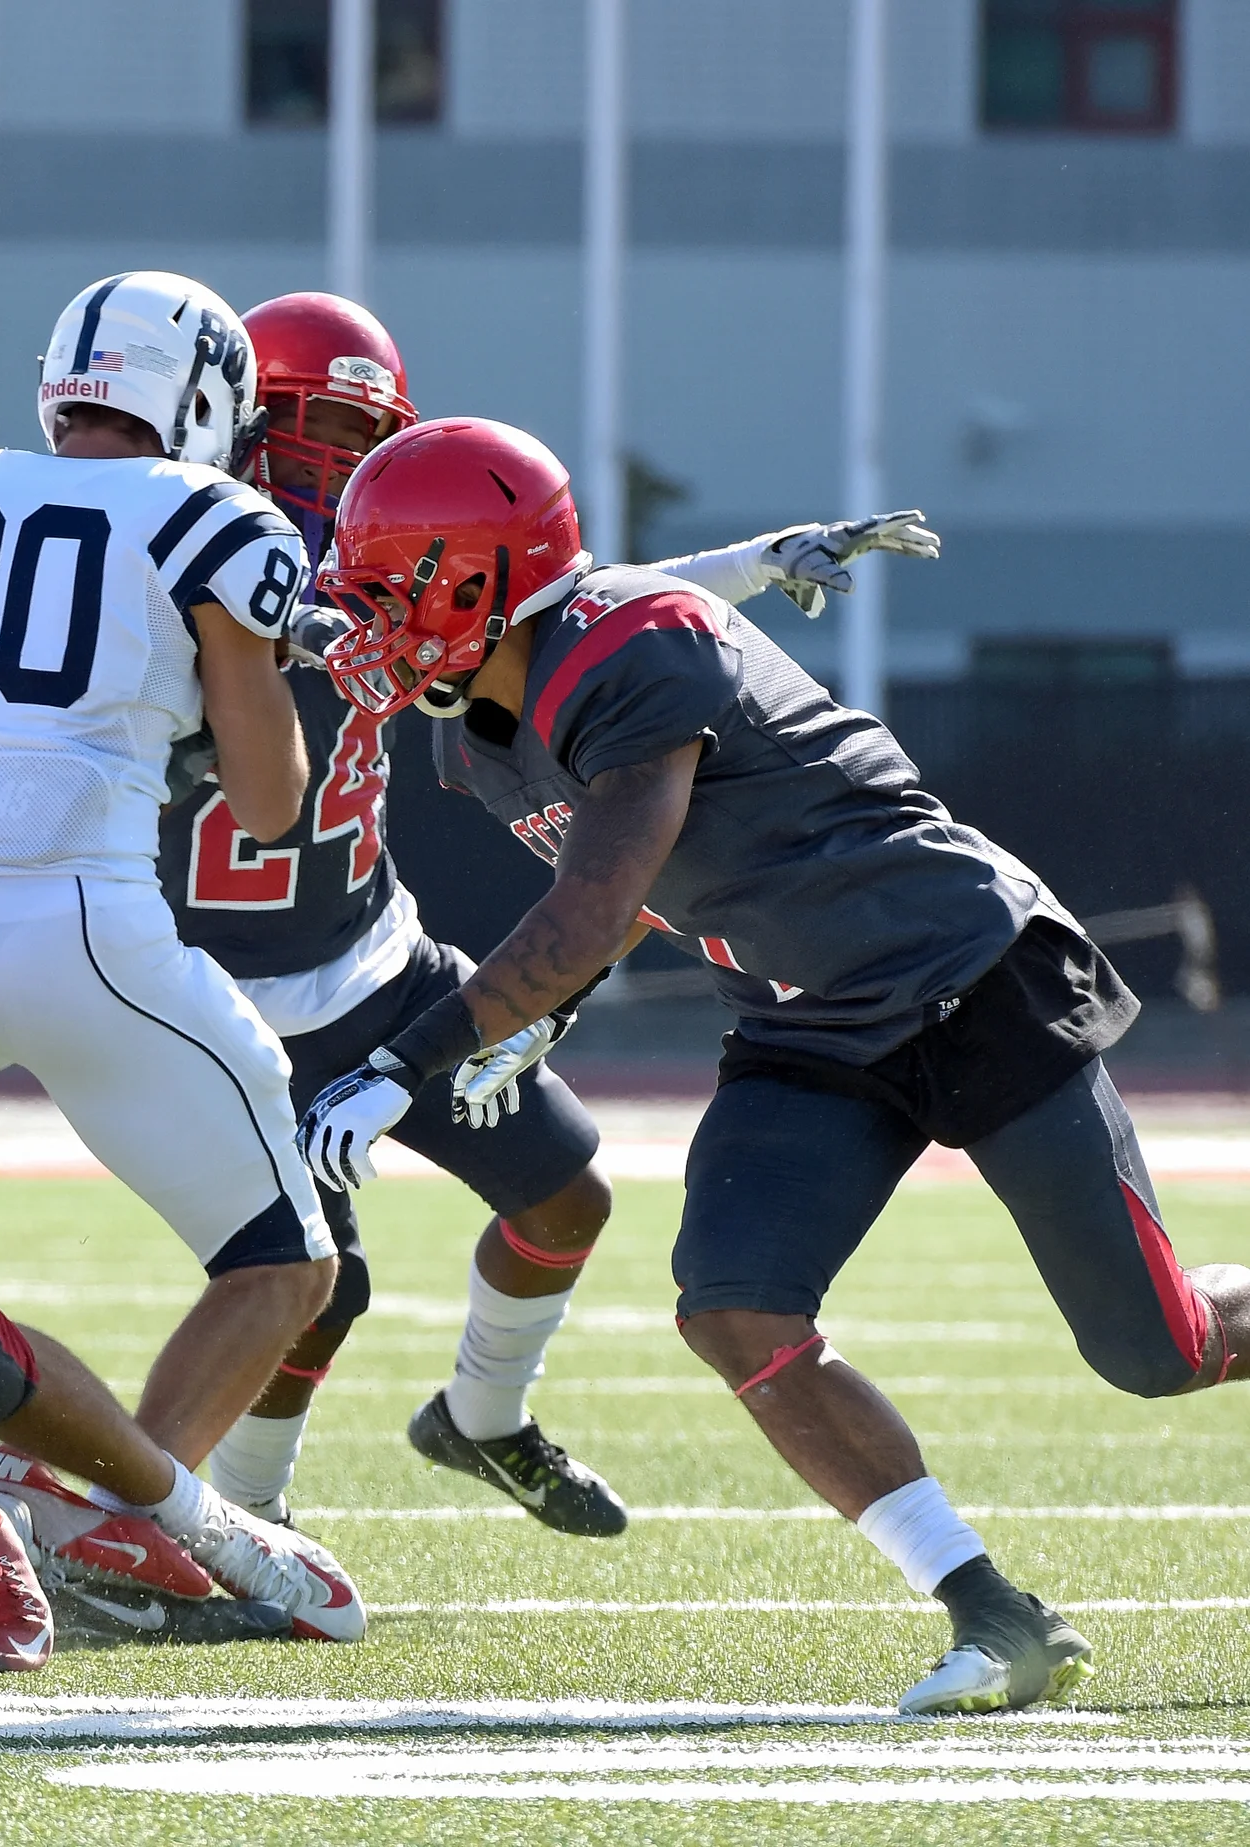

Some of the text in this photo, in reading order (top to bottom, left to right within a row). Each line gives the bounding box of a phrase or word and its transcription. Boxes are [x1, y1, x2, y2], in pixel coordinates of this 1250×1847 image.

[42, 378, 109, 400] Riddell
[186, 704, 388, 911] 24
[938, 997, 961, 1010] T&B
[328, 1085, 358, 1105] adizero
